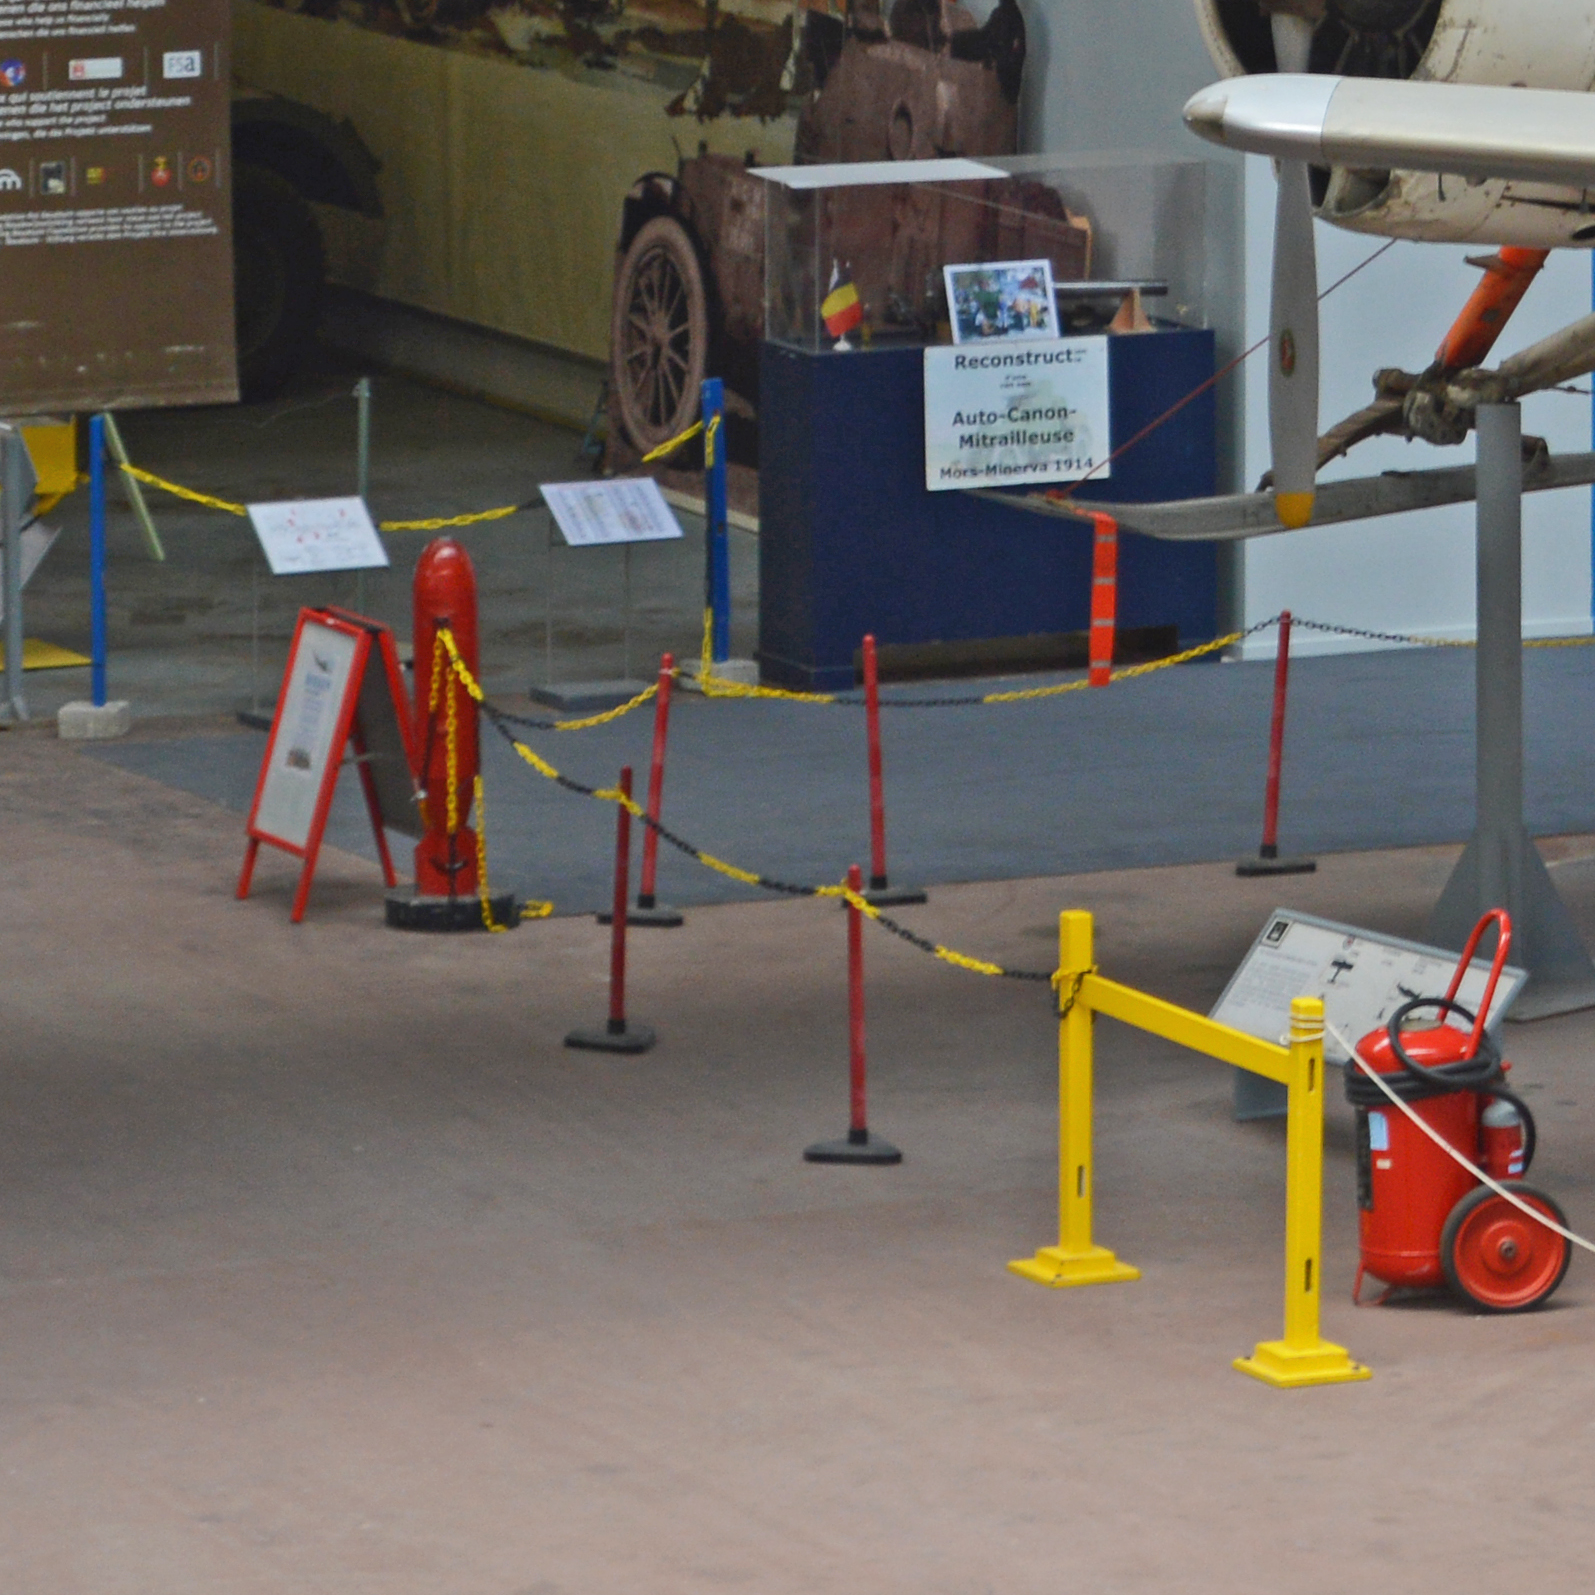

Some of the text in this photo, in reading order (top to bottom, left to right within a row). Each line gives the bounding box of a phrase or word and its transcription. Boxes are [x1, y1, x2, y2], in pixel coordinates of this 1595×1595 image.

[952, 406, 1077, 427] Auto-Canon-
[958, 428, 1075, 450] Mitrailleuse
[940, 457, 1094, 480] Mors-Minerva 1914
